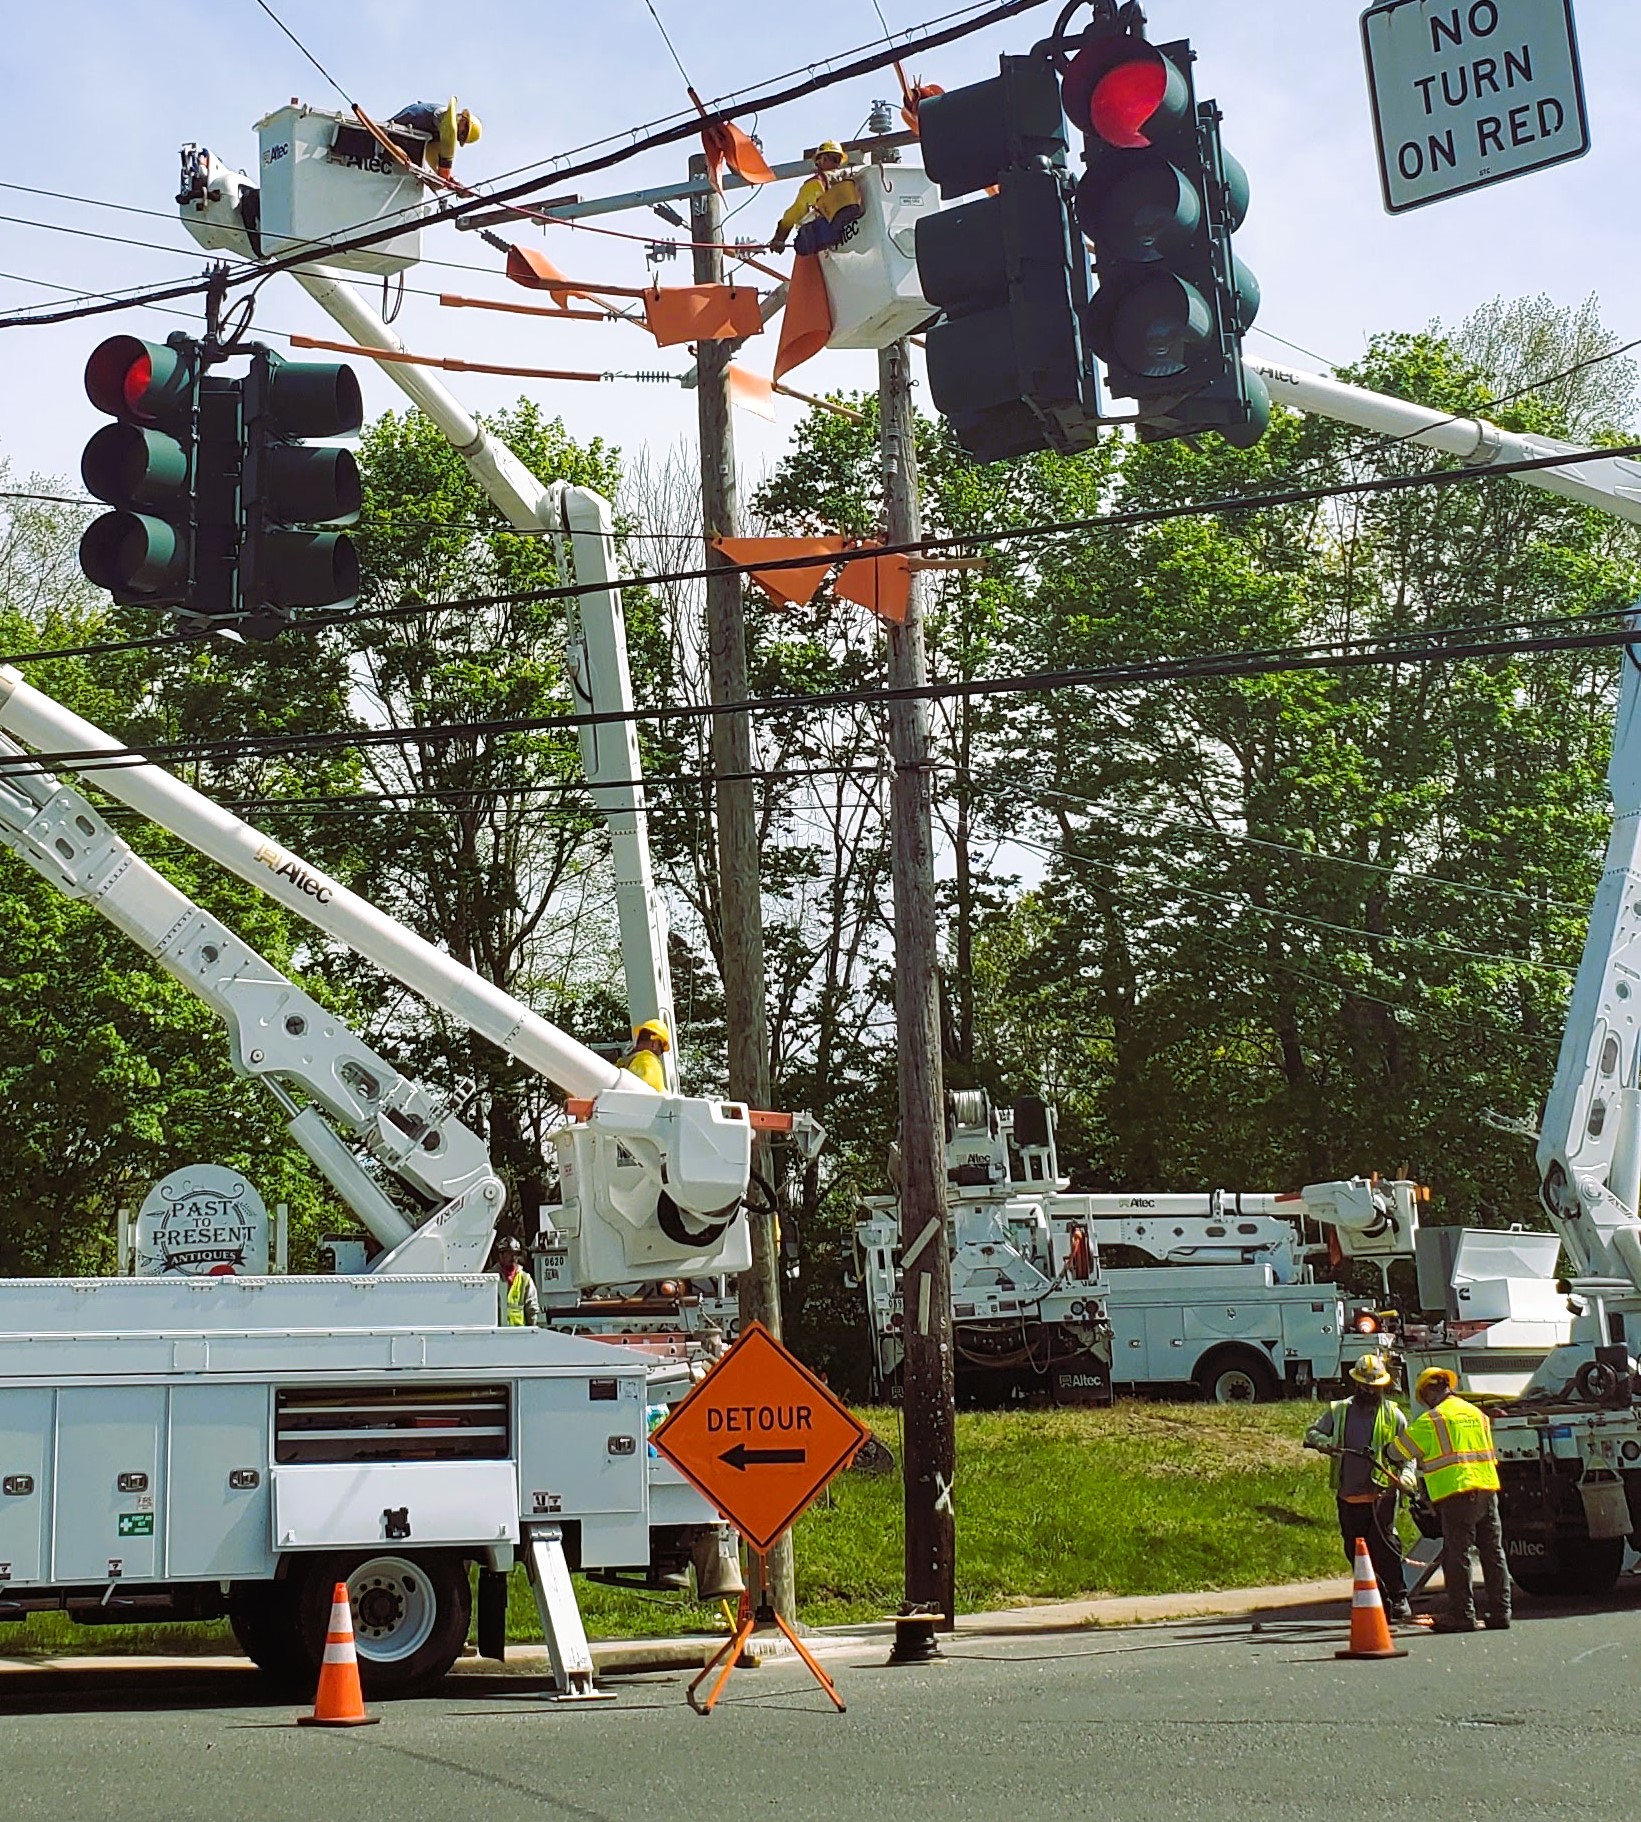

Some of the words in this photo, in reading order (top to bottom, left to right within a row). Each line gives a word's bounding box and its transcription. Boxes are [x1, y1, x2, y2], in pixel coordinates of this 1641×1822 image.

[1430, 0, 1498, 53] NO
[1413, 45, 1533, 115] TURN
[1398, 129, 1457, 180] ON
[1476, 97, 1564, 157] RED
[270, 142, 289, 164] Altec
[275, 861, 334, 904] Altec
[172, 1200, 232, 1218] PAST
[1130, 1197, 1155, 1208] Altec
[193, 1217, 212, 1228] TO
[153, 1226, 257, 1246] PRESENT
[171, 1250, 237, 1265] ANTIQUES
[544, 1256, 565, 1267] 0620
[1072, 1373, 1102, 1388] Altec
[707, 1405, 812, 1432] DETOUR
[1509, 1539, 1545, 1557] Altec
